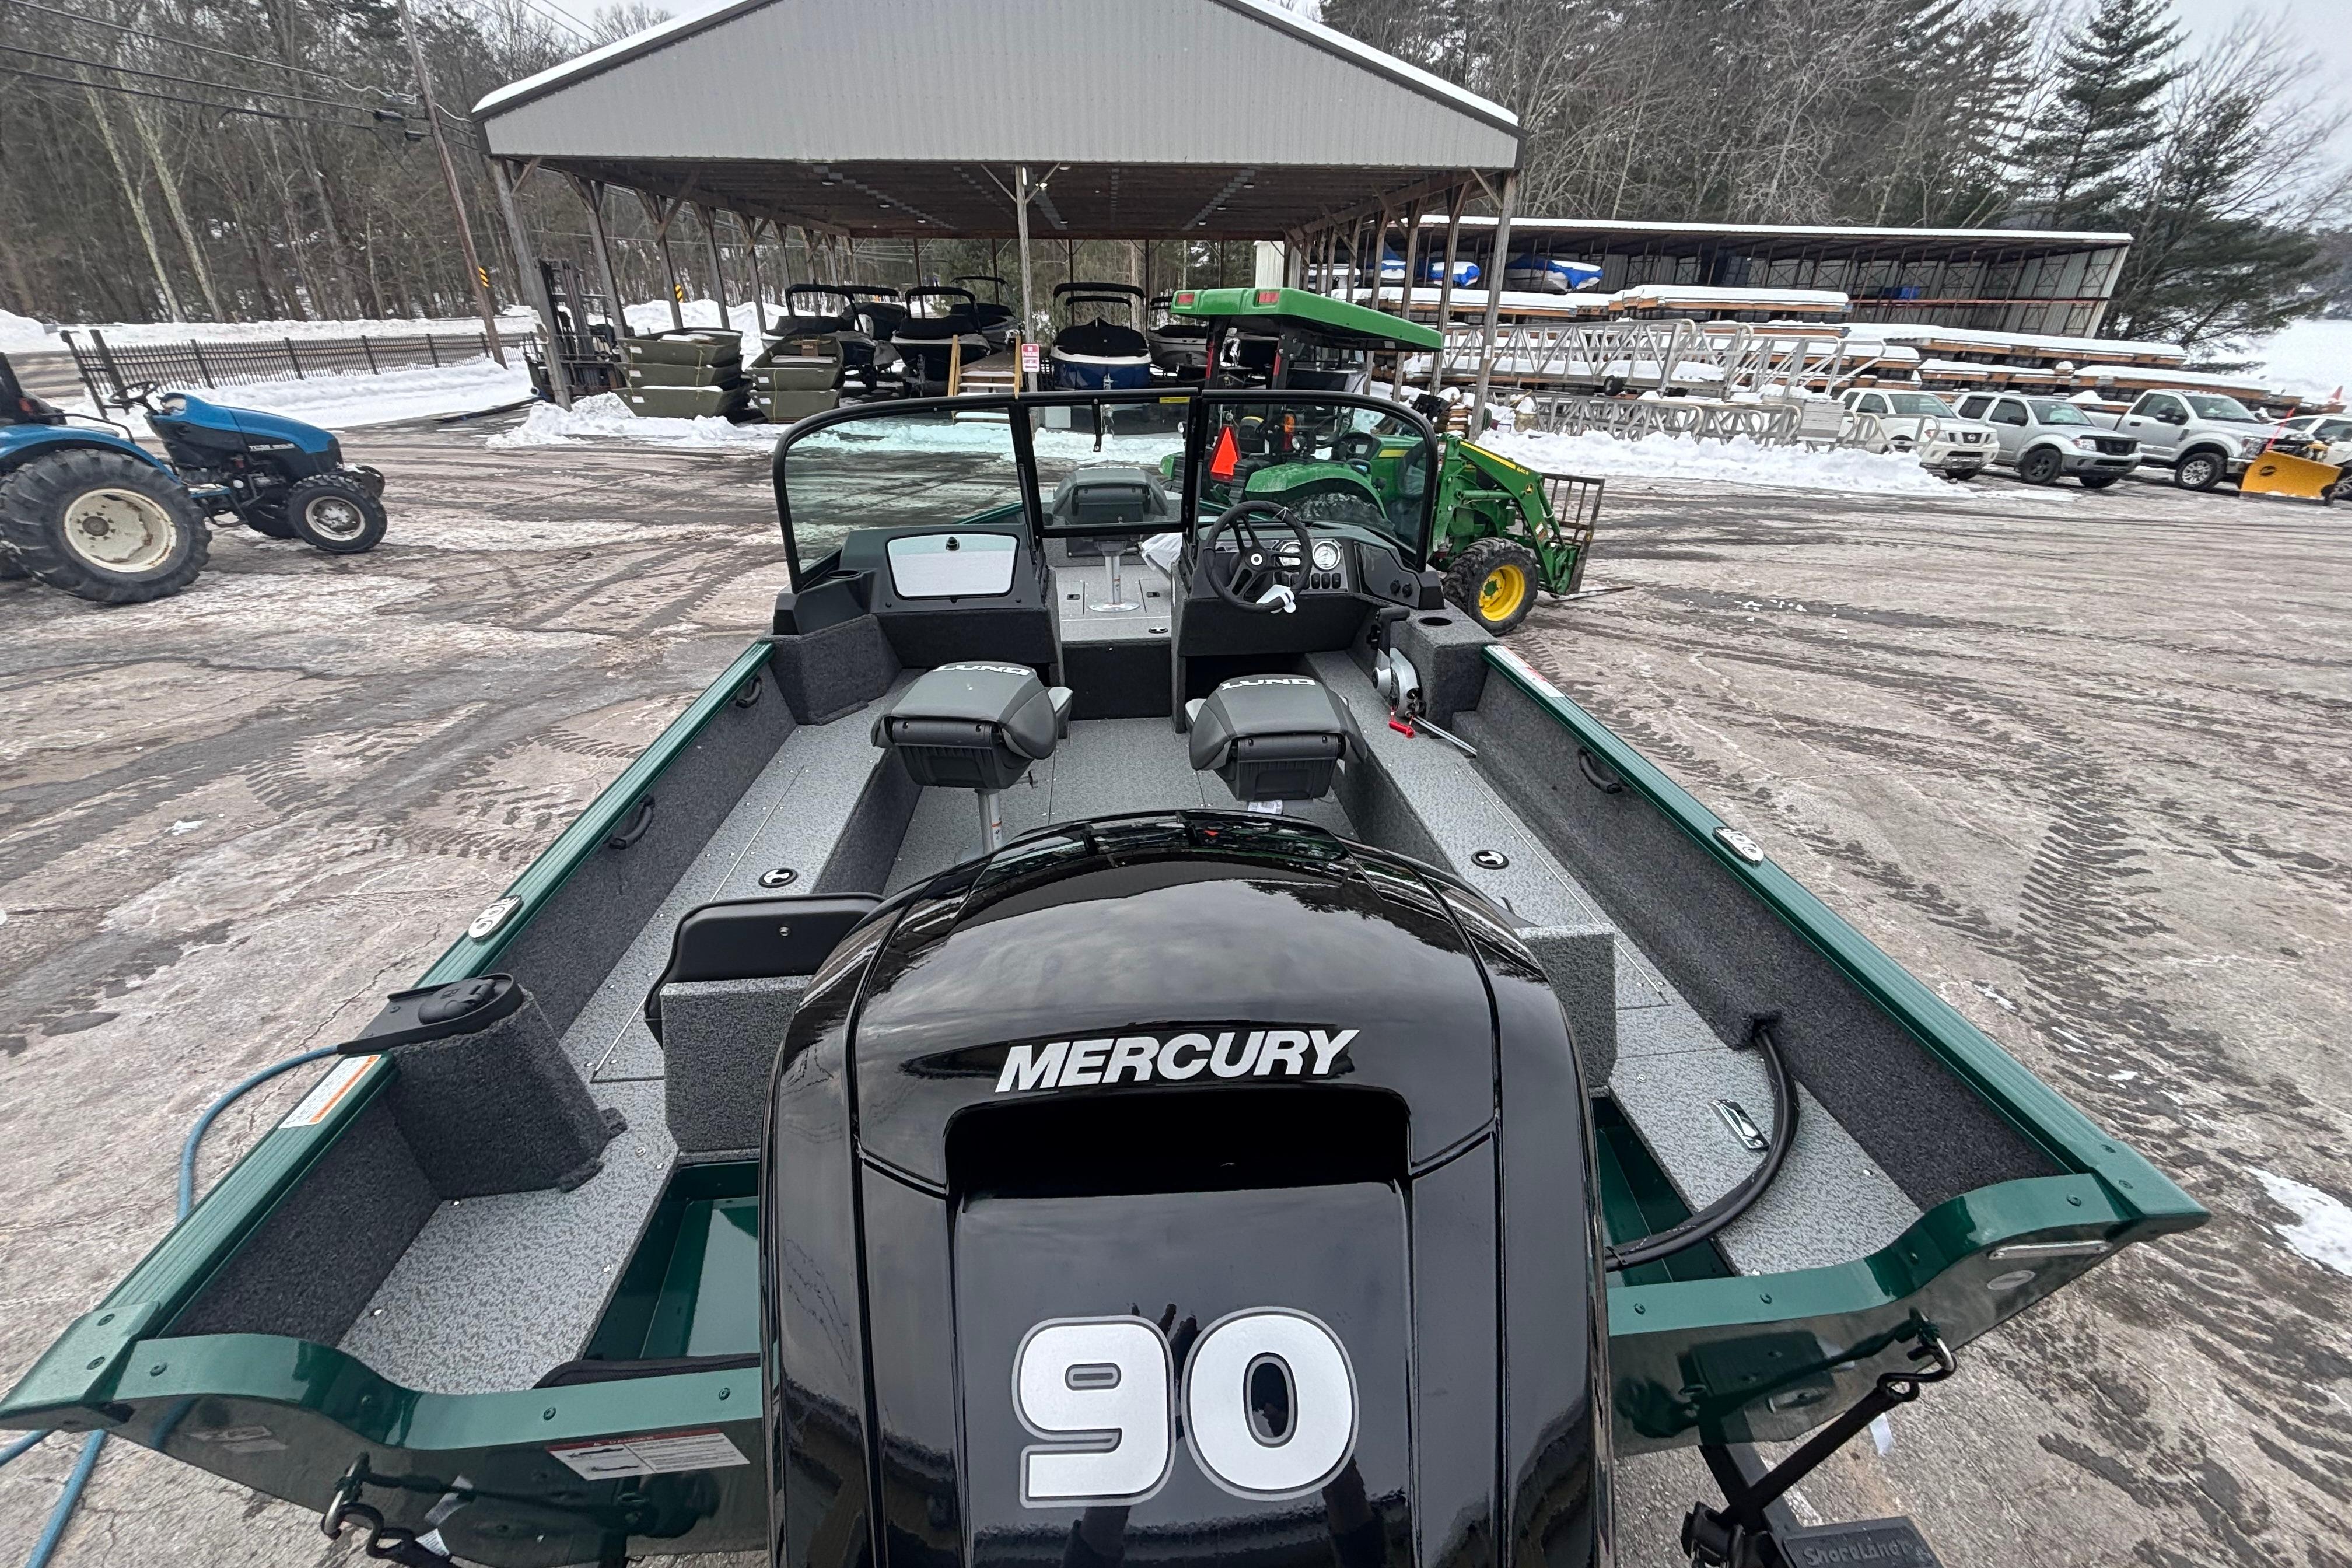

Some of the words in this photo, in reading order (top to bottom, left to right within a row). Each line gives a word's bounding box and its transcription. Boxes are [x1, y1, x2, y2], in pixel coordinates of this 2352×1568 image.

[933, 665, 1030, 676] LUND
[1222, 678, 1316, 690] LUND
[995, 1029, 1360, 1093] MERCURY
[1012, 1306, 1359, 1508] 90
[609, 1436, 654, 1444] DANGER
